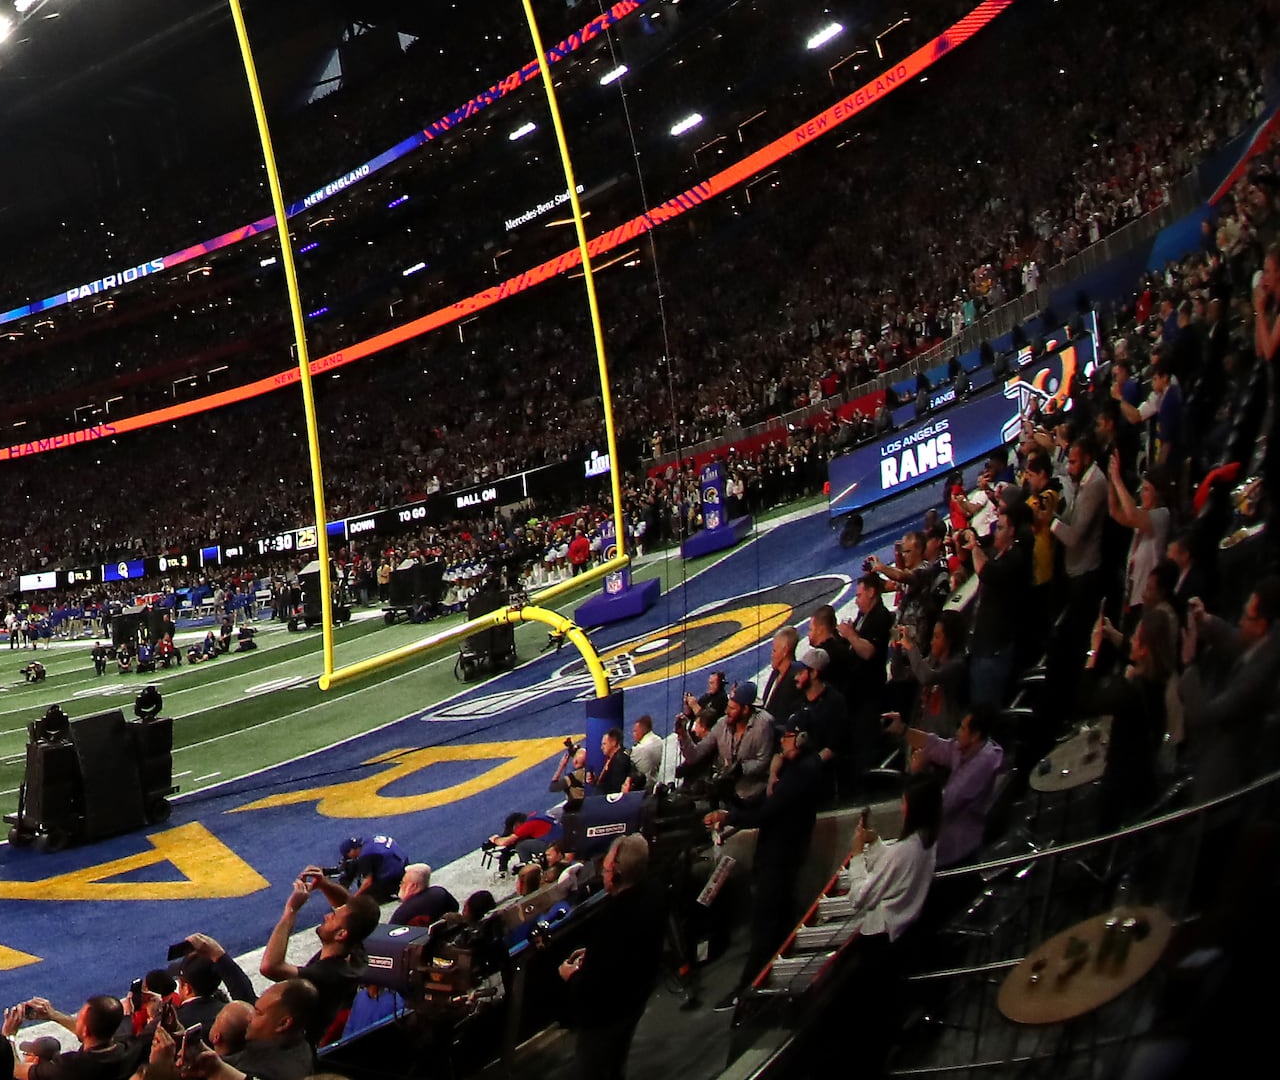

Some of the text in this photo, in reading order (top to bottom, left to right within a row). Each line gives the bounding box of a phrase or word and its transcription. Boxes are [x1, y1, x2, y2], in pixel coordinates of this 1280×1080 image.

[794, 64, 909, 143] NEW ENGLAND
[304, 164, 371, 208] NEW ENGLAND
[65, 256, 166, 304] PATRIOTS
[274, 372, 294, 385] NEW
[881, 418, 950, 457] LOS ANGELES
[880, 431, 954, 490] RAMS
[456, 487, 497, 508] BALL ON
[398, 506, 426, 522] TO GO
[349, 519, 375, 534] DOWN
[297, 527, 316, 548] 25
[168, 557, 180, 568] TOL
[181, 555, 188, 567] 3
[85, 569, 92, 581] 3
